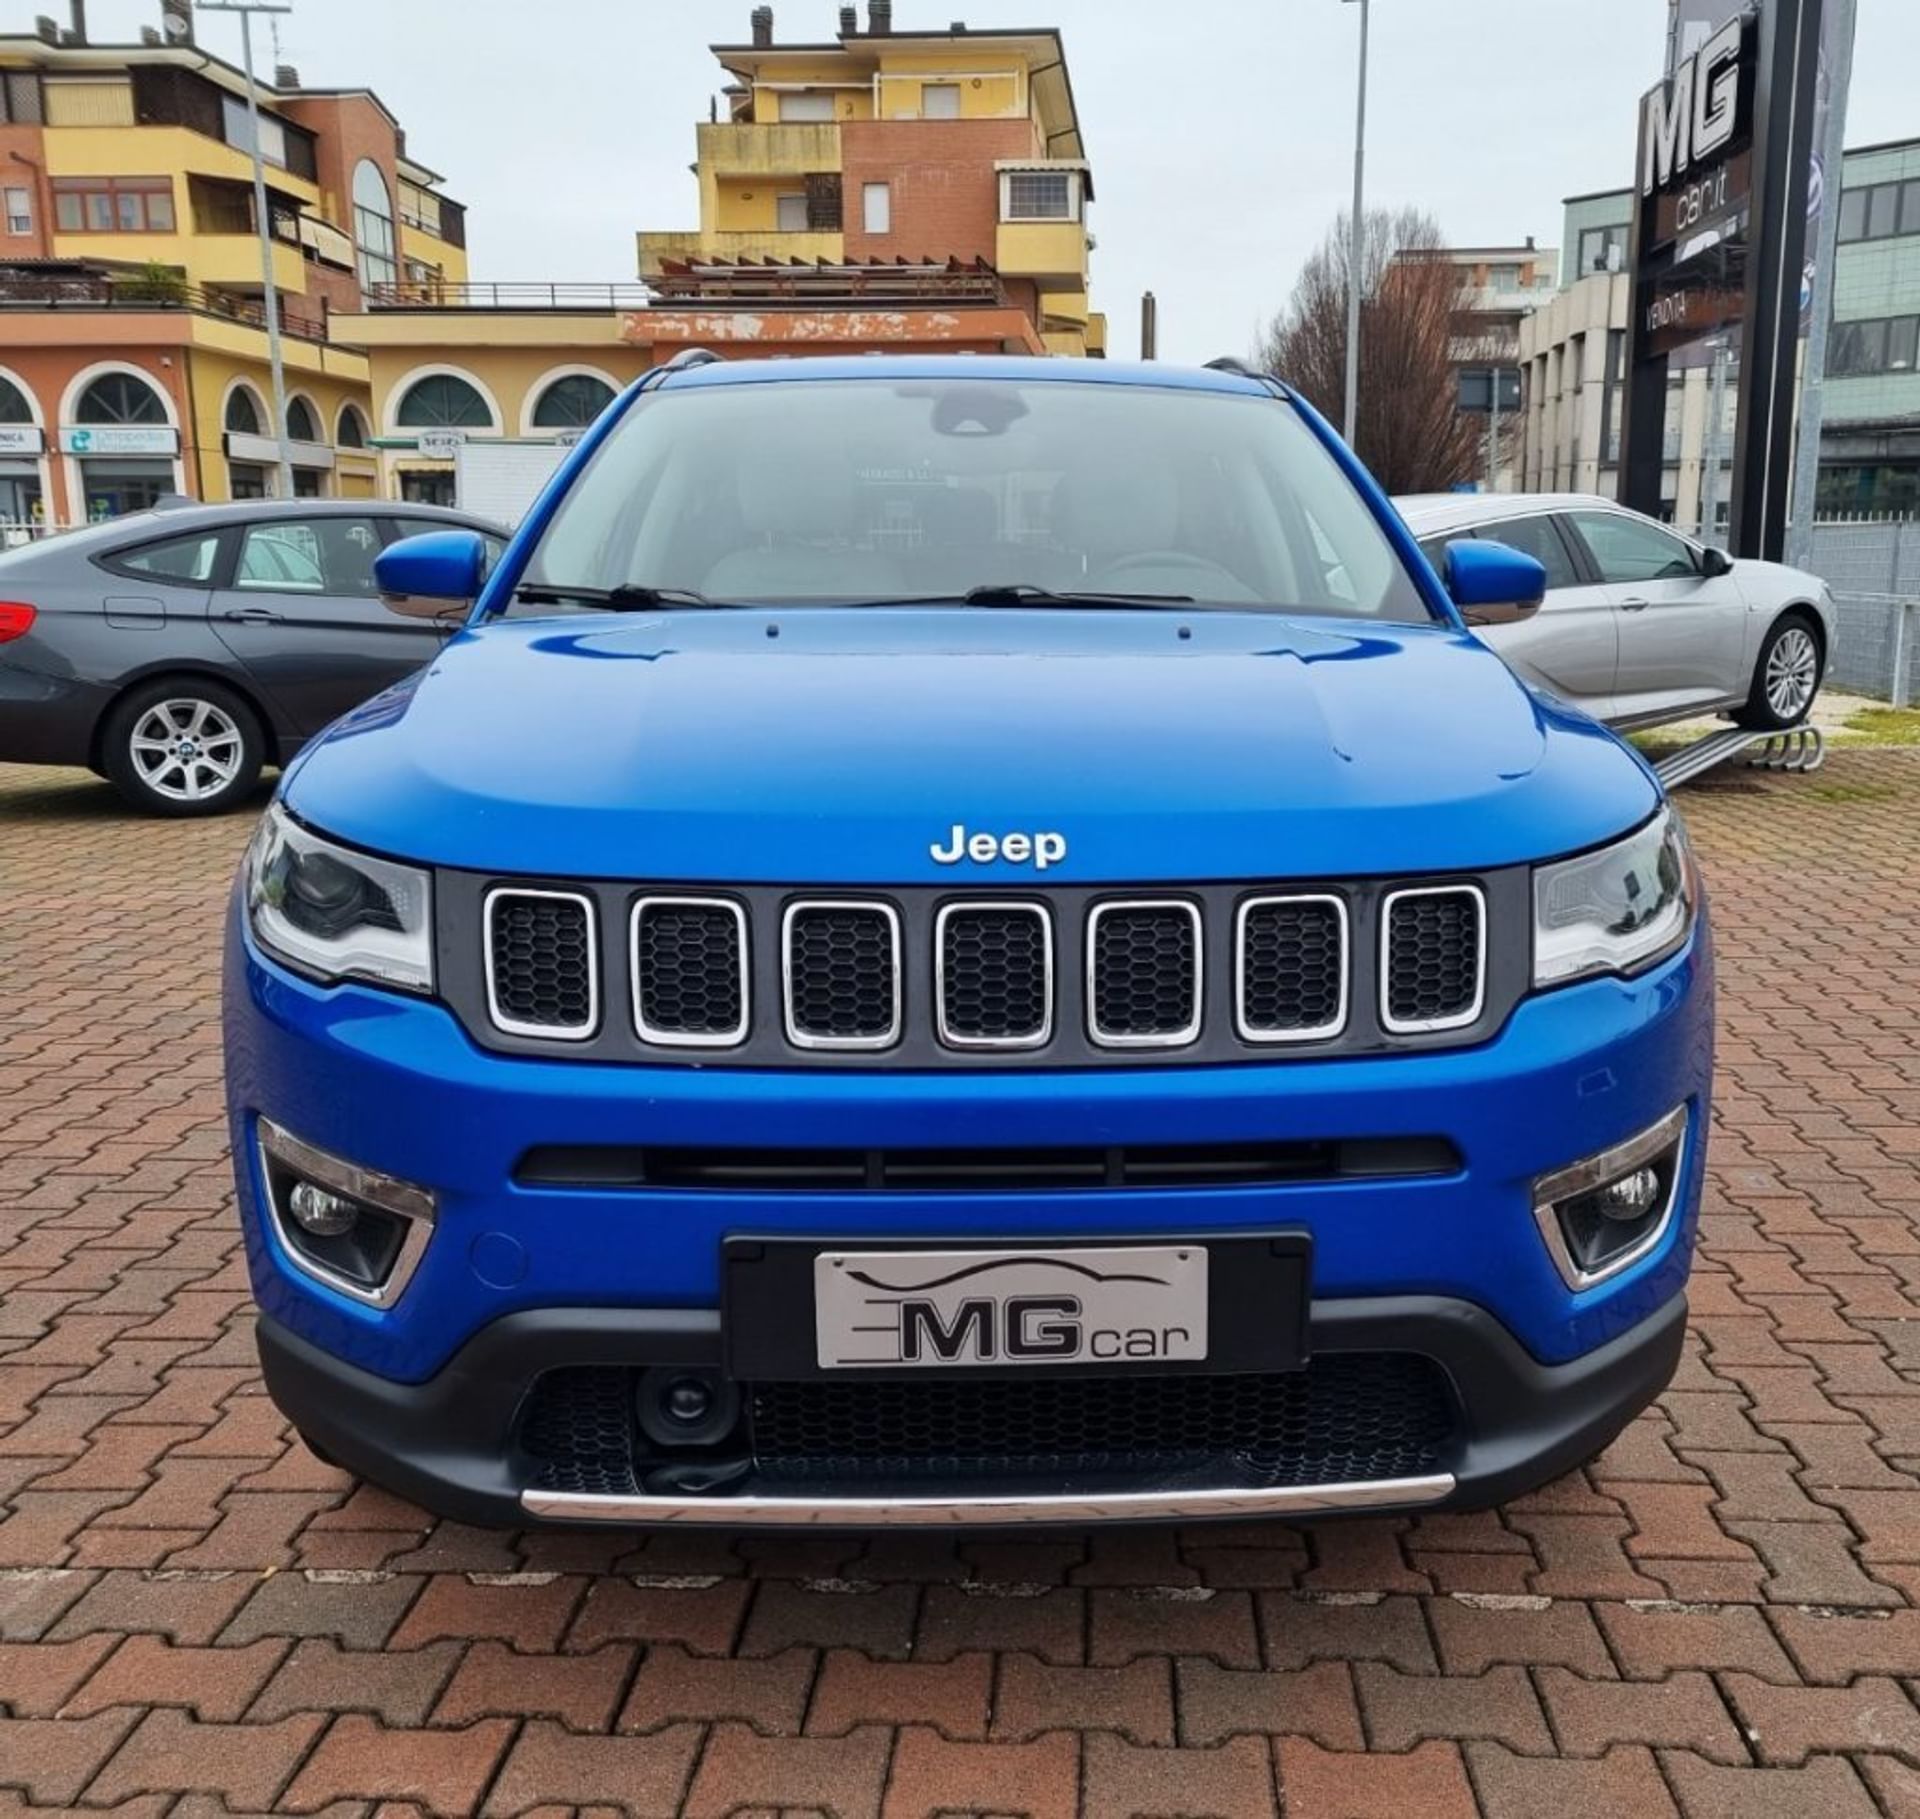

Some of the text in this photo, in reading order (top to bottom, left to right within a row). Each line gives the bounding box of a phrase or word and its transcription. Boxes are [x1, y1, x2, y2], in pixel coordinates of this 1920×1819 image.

[1642, 15, 1742, 197] MG
[1676, 165, 1727, 230] car.it
[930, 824, 1067, 869] Jeep
[901, 1295, 1190, 1361] MG car
